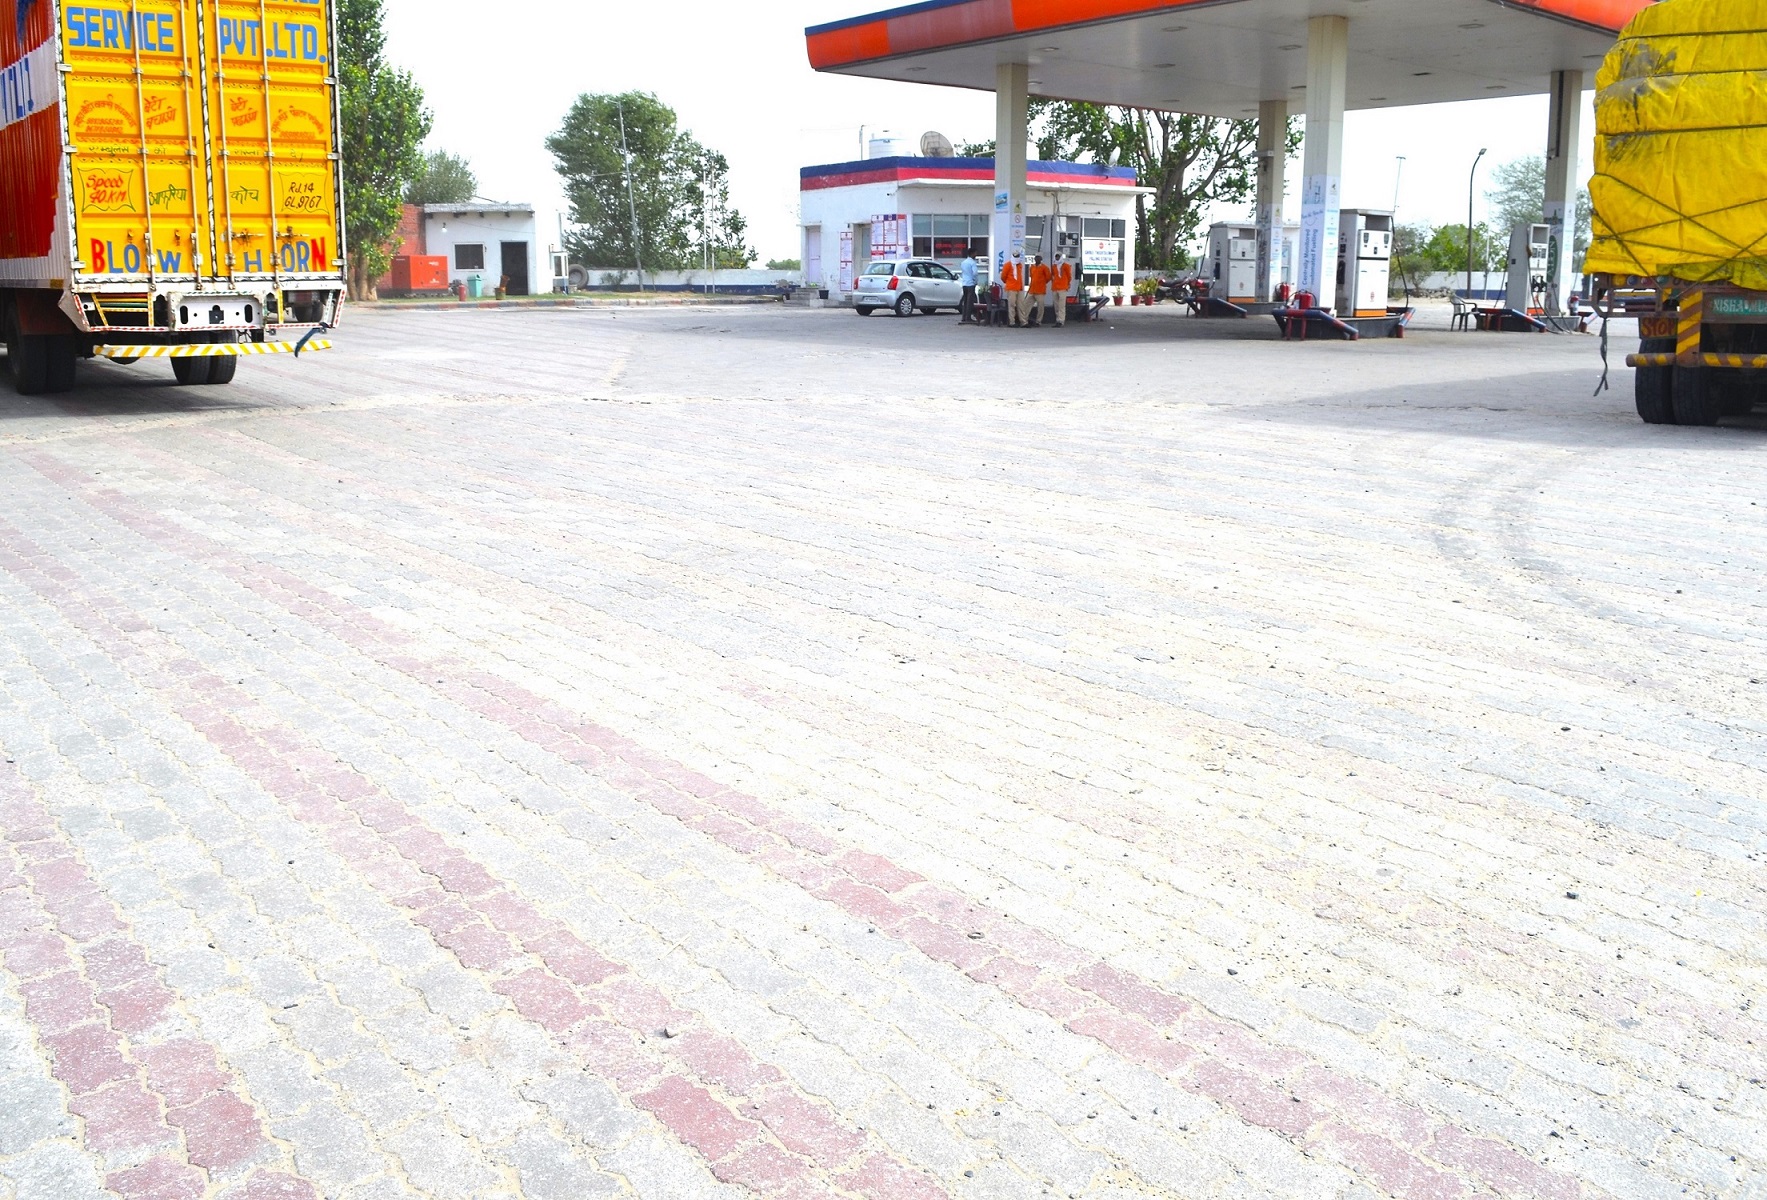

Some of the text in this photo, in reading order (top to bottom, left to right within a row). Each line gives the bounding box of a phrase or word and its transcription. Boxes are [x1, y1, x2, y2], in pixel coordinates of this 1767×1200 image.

[66, 6, 174, 52] SERVICE
[144, 95, 167, 113] बेटी
[86, 174, 124, 190] Speed
[229, 185, 260, 205] कोच
[284, 195, 322, 209] GL.9767
[1303, 229, 1311, 258] Monitored
[1311, 229, 1319, 252] Fuelling
[1641, 317, 1676, 337] STOP
